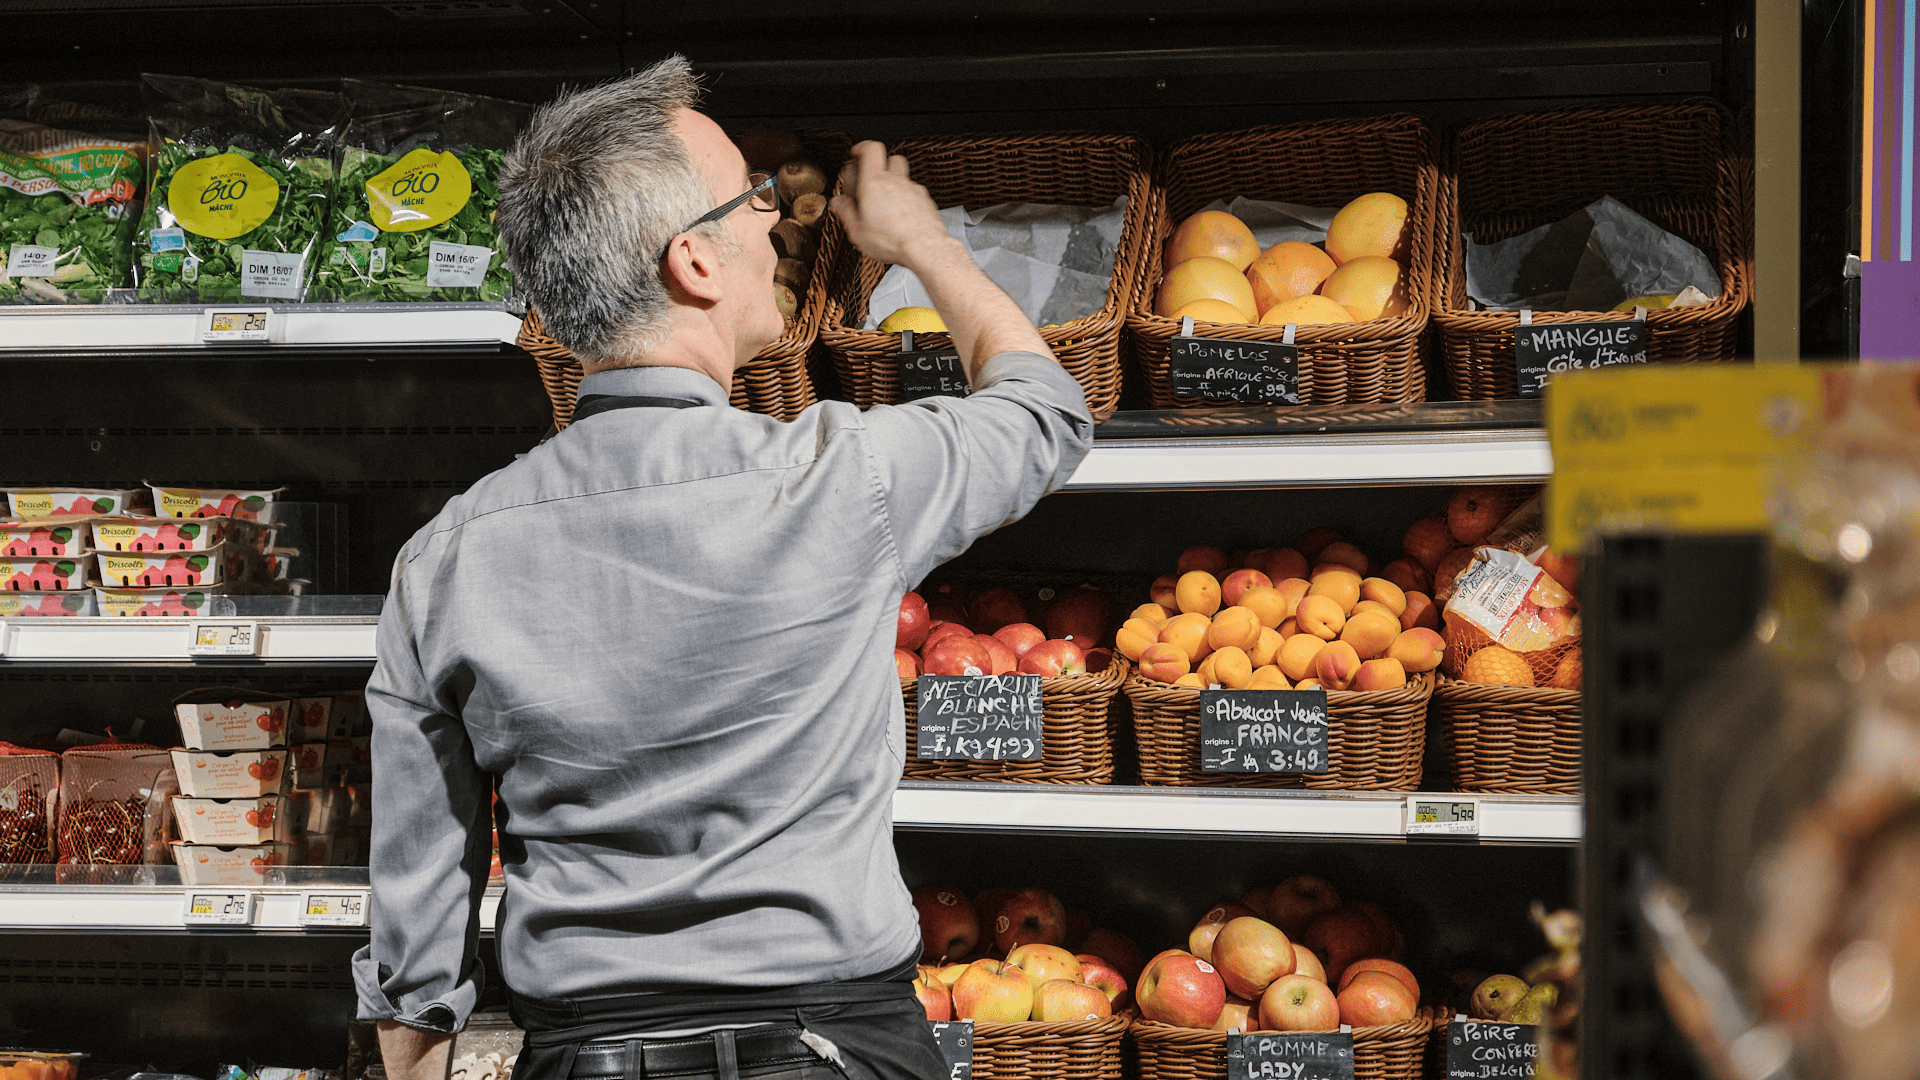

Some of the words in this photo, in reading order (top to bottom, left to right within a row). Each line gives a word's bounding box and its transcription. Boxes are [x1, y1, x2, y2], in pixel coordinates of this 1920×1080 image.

[436, 253, 455, 263] DIM
[249, 264, 268, 274] DIM
[272, 266, 293, 276] 16/07
[1532, 326, 1630, 352] MANGUE
[1188, 343, 1269, 361] POMELOS
[917, 356, 959, 371] CIT
[1547, 350, 1583, 373] Côte
[1206, 367, 1262, 382] AFRIQUE
[17, 500, 51, 508] Driscoll's
[163, 497, 198, 505] Driscoll's
[108, 560, 144, 568] Driscoll's
[937, 694, 1042, 715] BLANCHE
[921, 724, 946, 732] origine
[1205, 738, 1230, 746] origine
[1238, 723, 1322, 747] FRANCE
[1259, 1038, 1329, 1057] POMME
[1472, 1043, 1539, 1061] CONFERE
[1248, 1061, 1305, 1080] LADY
[1450, 1070, 1475, 1078] origine
[1480, 1062, 1537, 1078] BELGIQ
